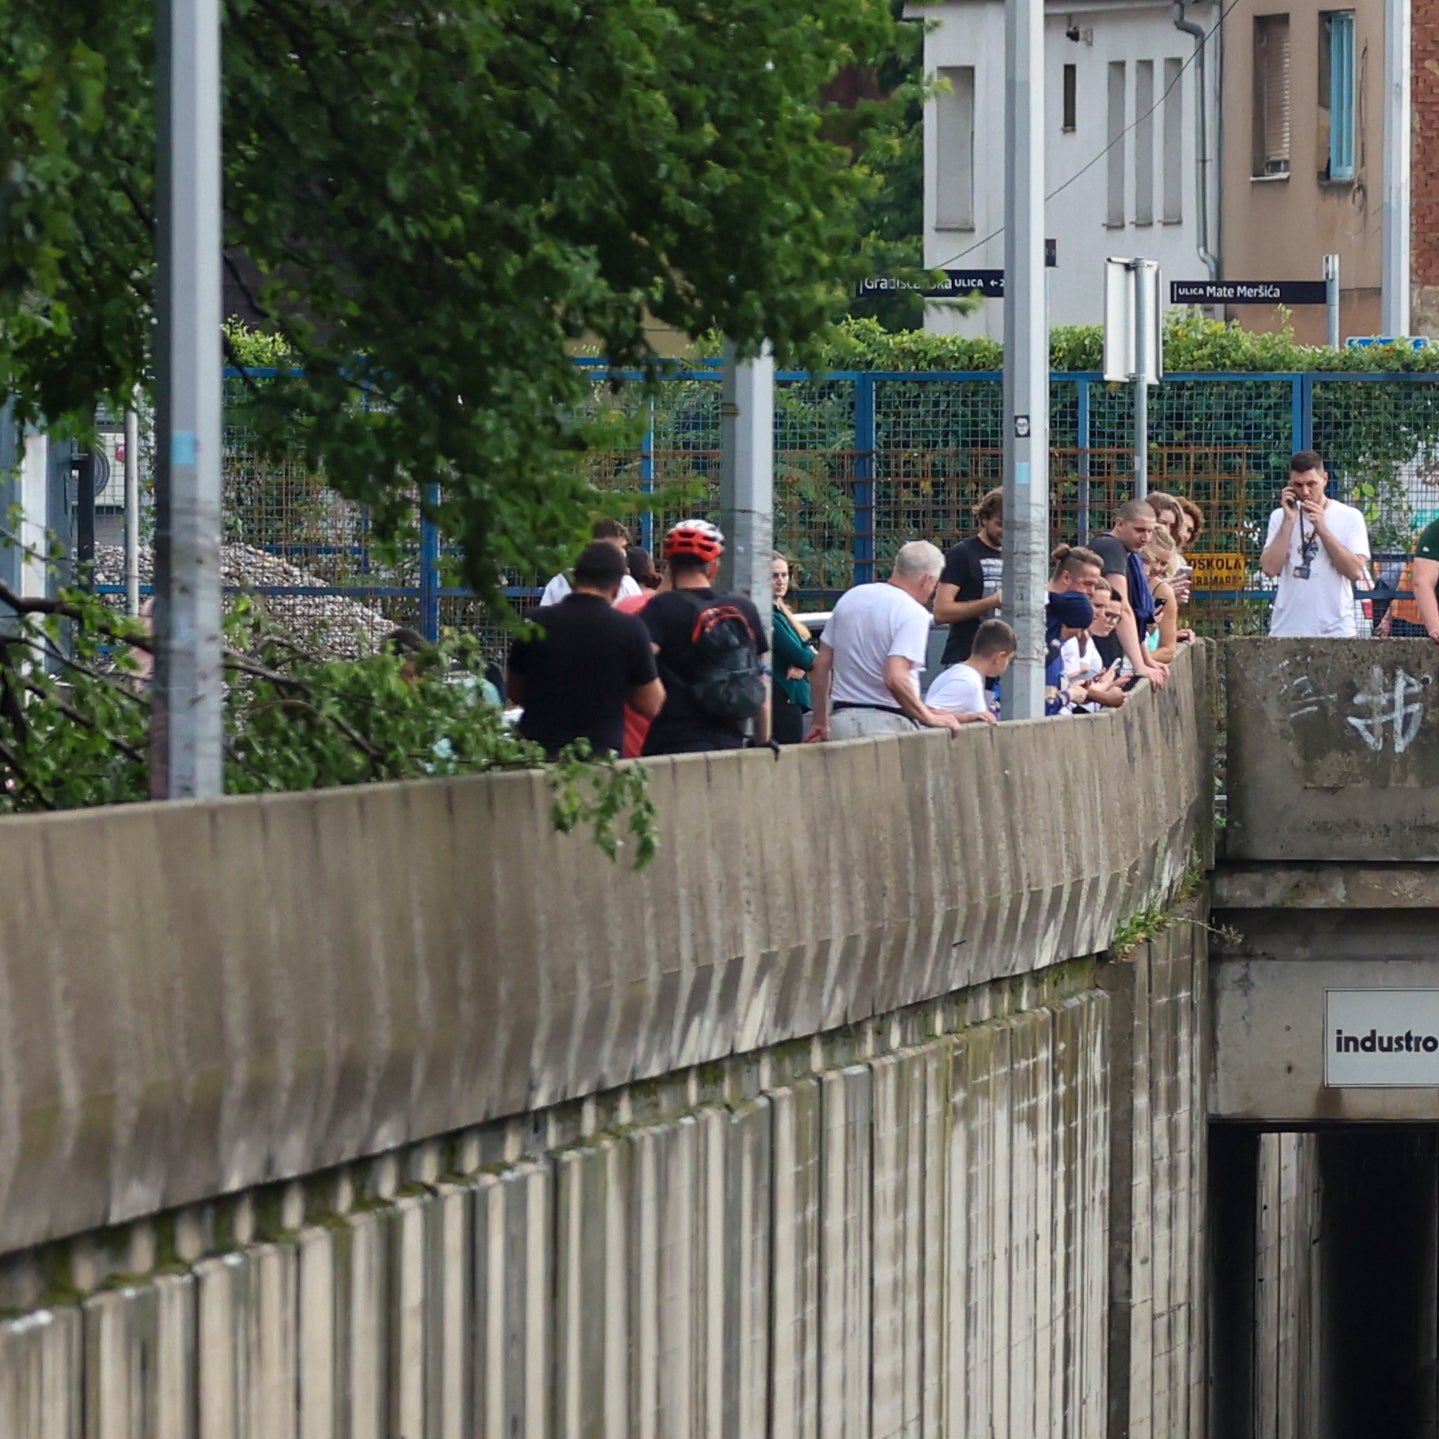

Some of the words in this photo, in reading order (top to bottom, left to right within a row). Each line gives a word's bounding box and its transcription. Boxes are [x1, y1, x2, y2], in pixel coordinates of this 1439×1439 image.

[954, 278, 984, 288] ULICA
[1178, 287, 1204, 295] ULICA
[1206, 285, 1235, 298] Mate
[1236, 284, 1281, 298] Meršića
